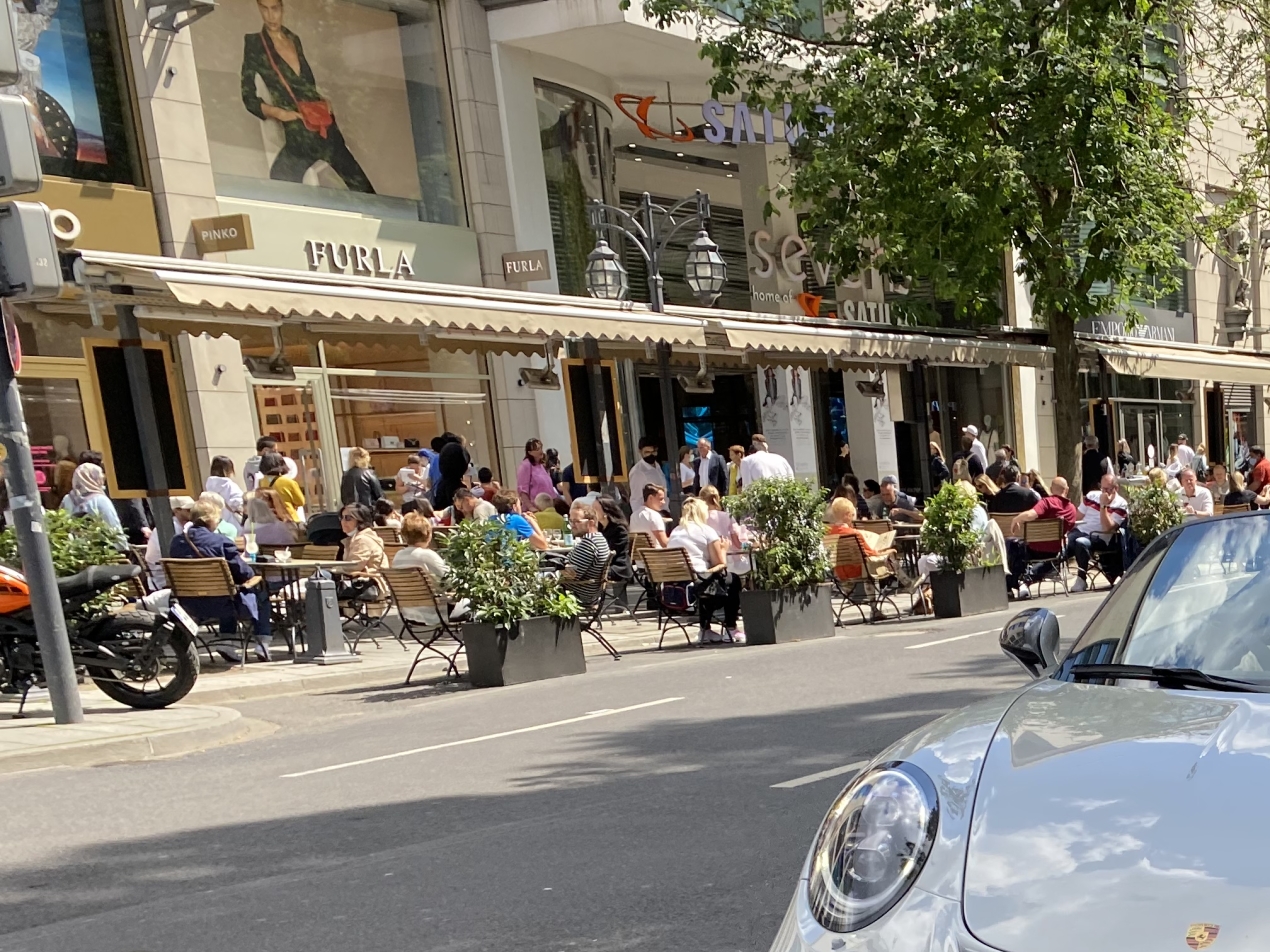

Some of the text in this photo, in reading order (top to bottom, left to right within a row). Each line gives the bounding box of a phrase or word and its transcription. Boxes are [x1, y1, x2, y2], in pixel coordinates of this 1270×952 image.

[201, 227, 238, 241] PINKO
[305, 239, 416, 276] FURLA
[505, 259, 544, 274] FURLA
[752, 285, 780, 303] home
[782, 288, 793, 303] of
